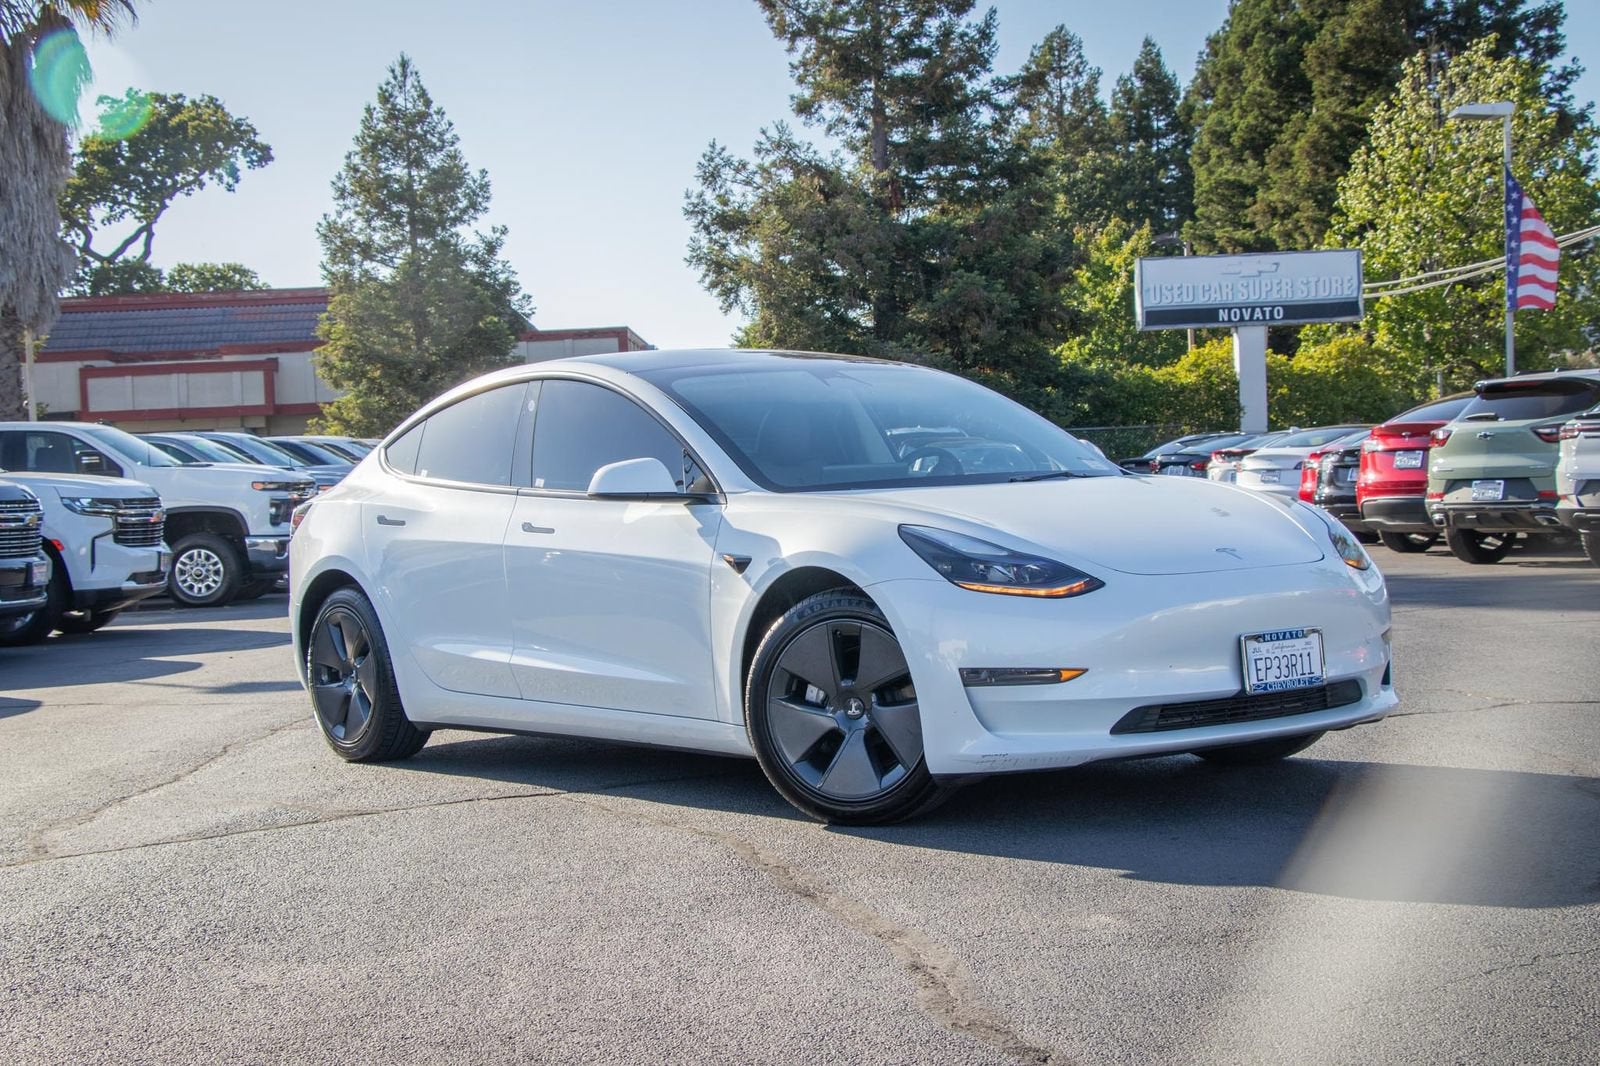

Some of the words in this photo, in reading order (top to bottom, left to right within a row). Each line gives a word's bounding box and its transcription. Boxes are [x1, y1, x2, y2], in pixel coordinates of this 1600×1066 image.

[1151, 283, 1194, 304] USED
[1201, 281, 1233, 302] CAR
[1239, 278, 1293, 301] SUPER
[1300, 276, 1354, 298] STORE
[1218, 306, 1284, 322] NOVATO
[1265, 631, 1303, 641] NOVATO
[1253, 652, 1315, 682] EP33R11
[1266, 678, 1310, 691] CHEVROLET
